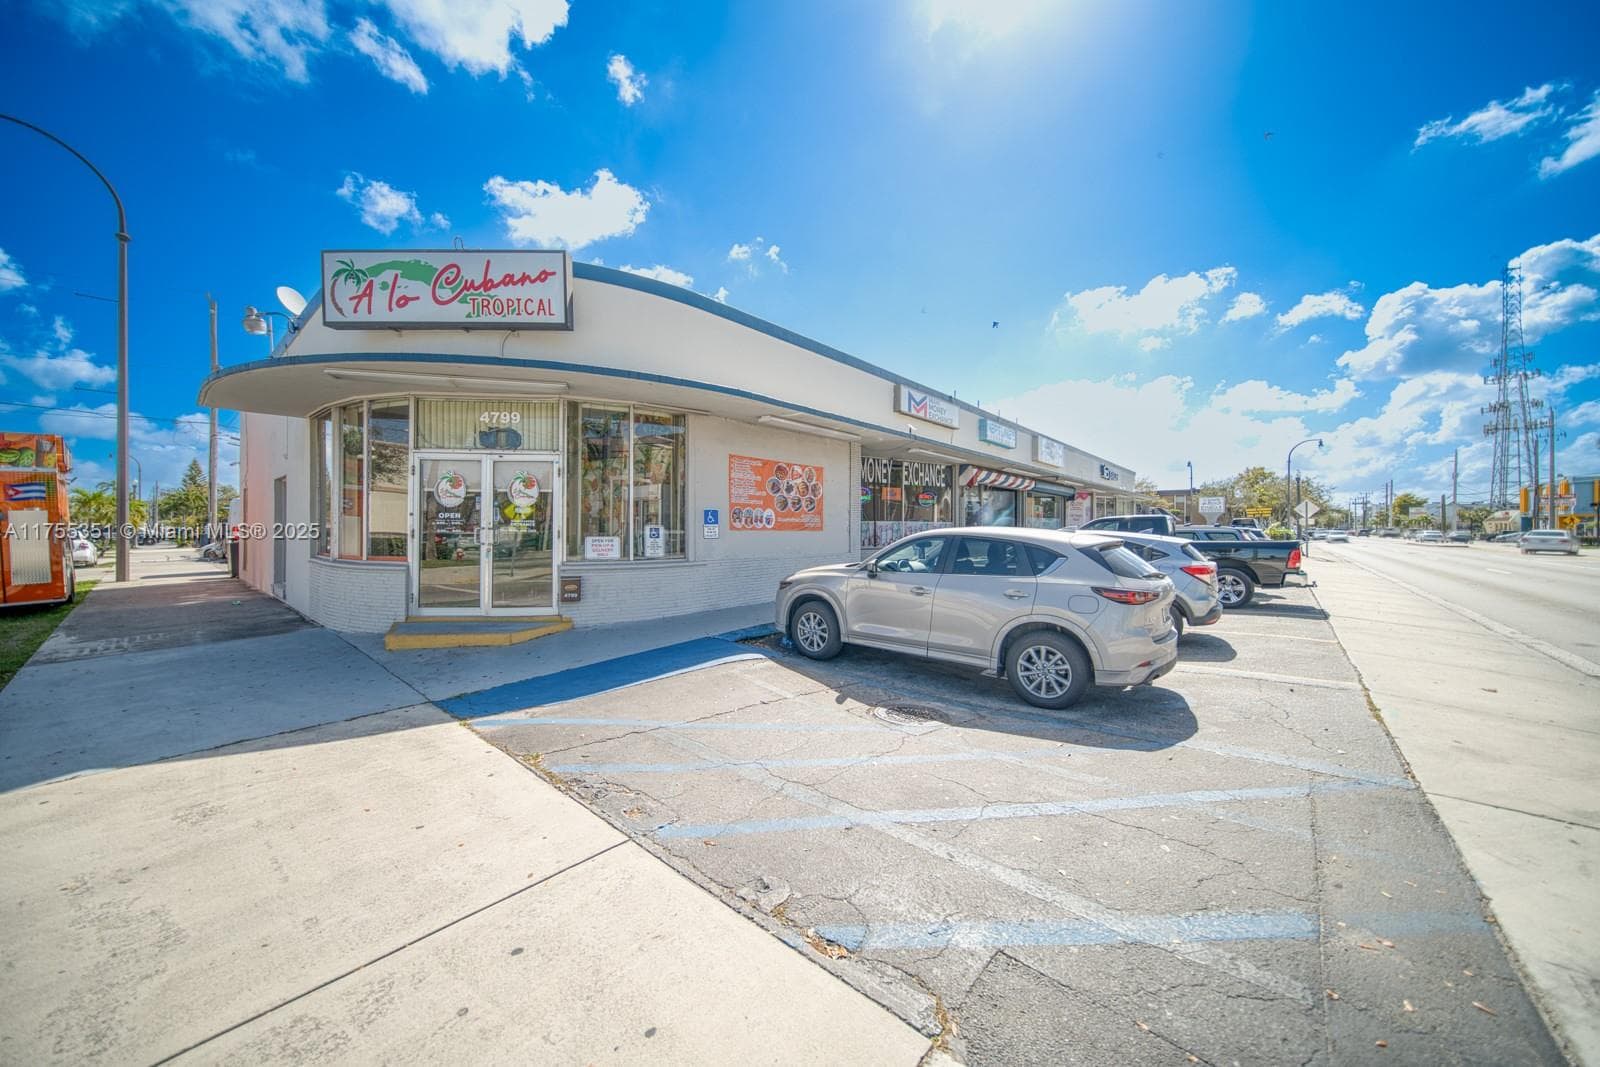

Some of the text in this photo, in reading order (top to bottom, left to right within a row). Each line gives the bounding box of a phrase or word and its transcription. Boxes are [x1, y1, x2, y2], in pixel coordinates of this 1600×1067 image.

[348, 279, 375, 314] A
[431, 259, 557, 306] Cubano
[469, 297, 556, 317] TROPICAL
[479, 411, 521, 425] 4799
[861, 457, 946, 487] MONEY EXCHANGE
